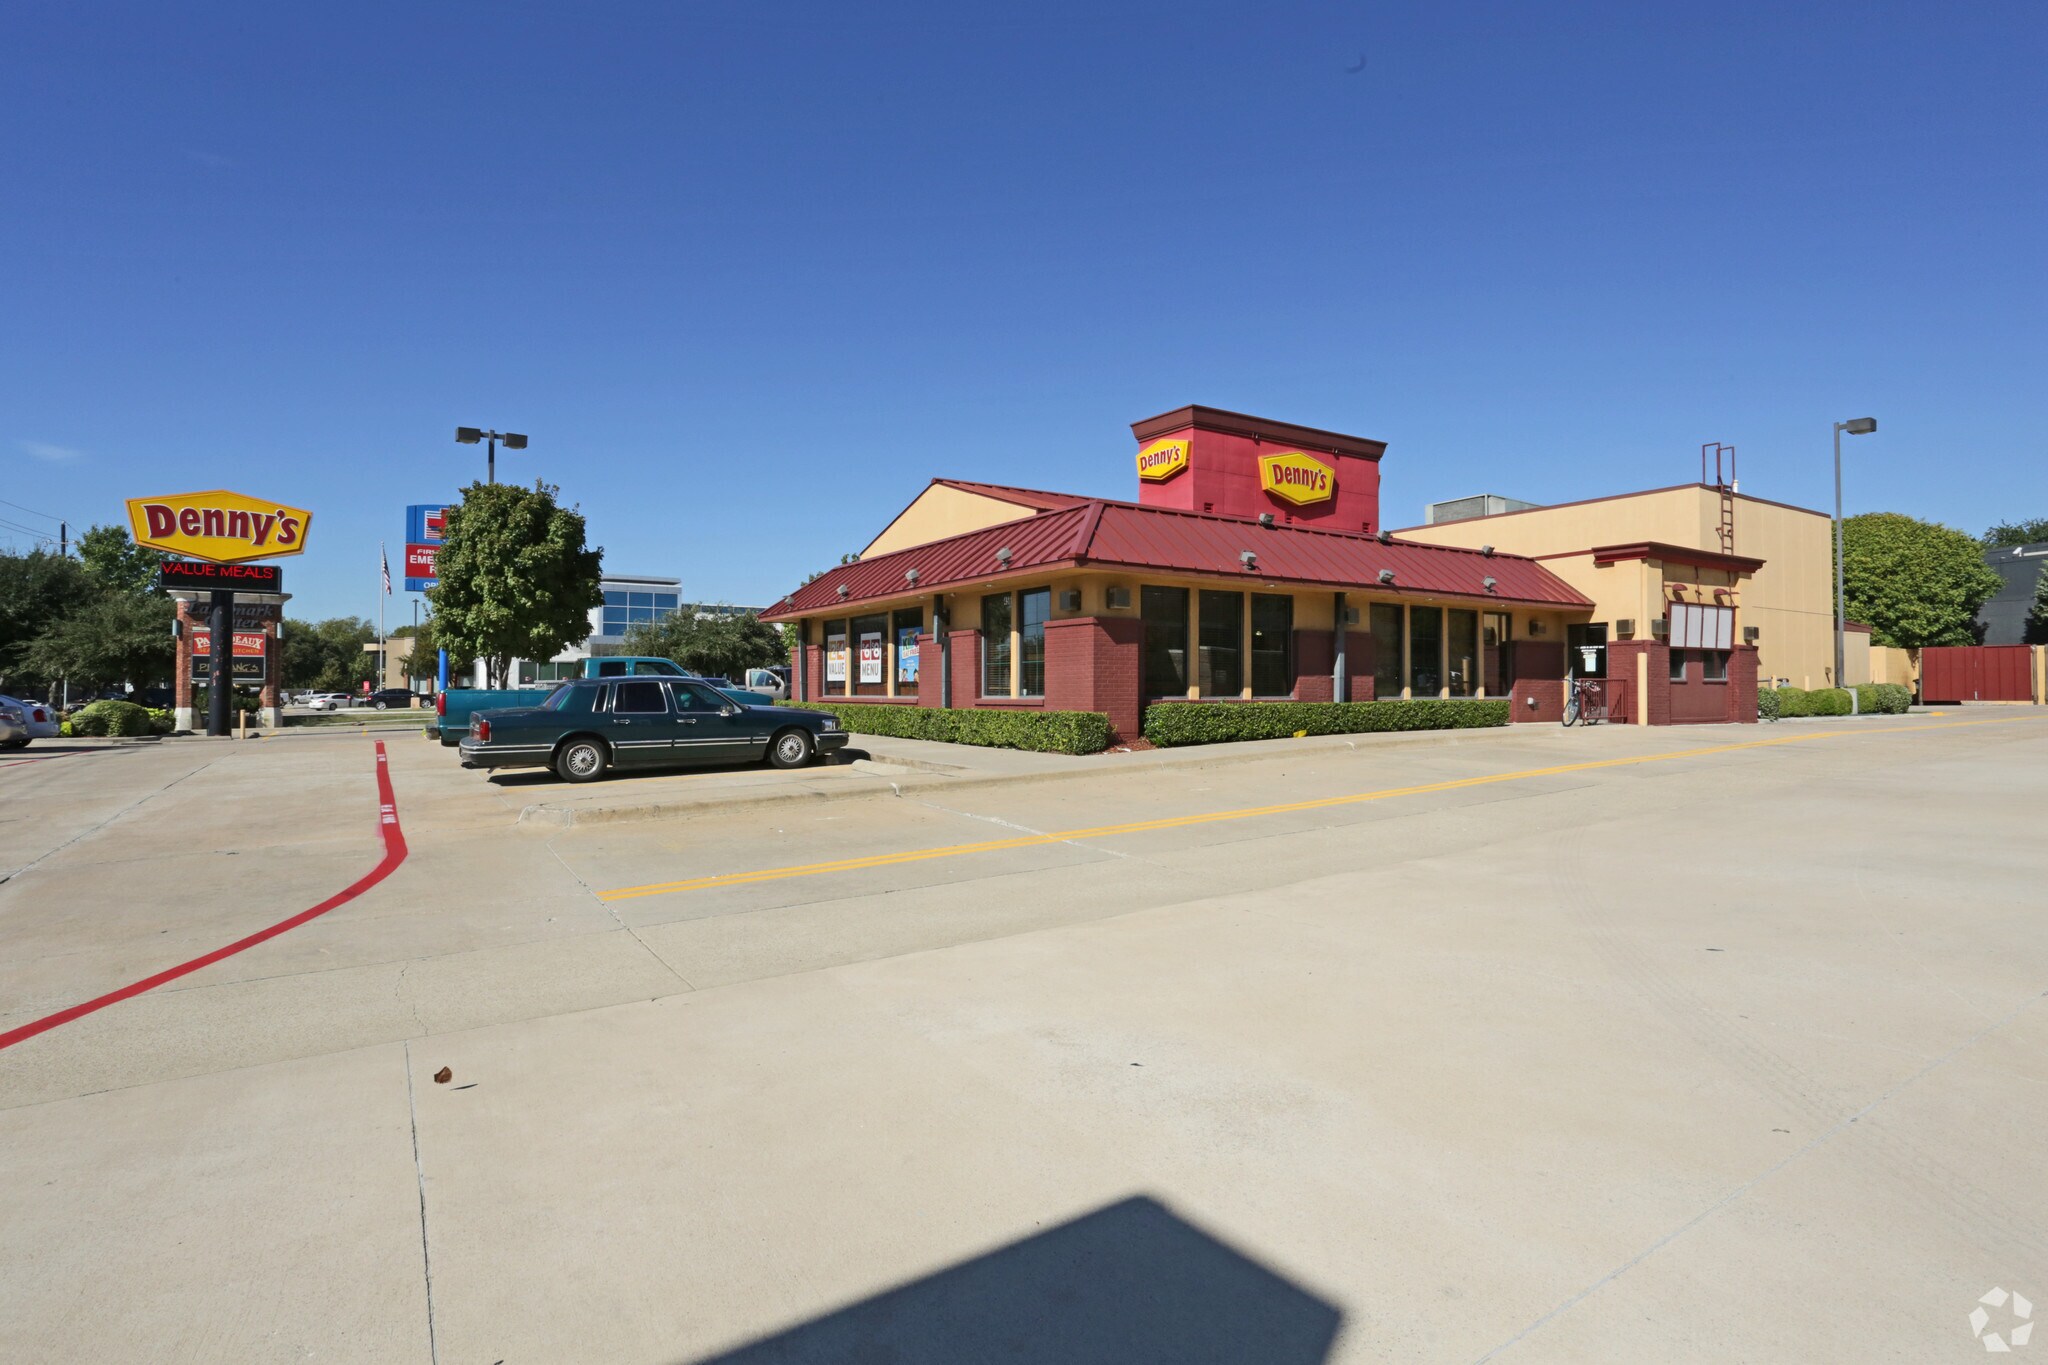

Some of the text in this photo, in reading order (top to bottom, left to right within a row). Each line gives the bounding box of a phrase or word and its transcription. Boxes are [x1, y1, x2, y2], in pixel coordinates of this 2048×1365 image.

[1140, 446, 1181, 471] Denny's
[1272, 464, 1326, 491] Denny's
[142, 503, 299, 547] Denny's
[161, 562, 273, 579] VALUE MEALS
[828, 662, 845, 675] VALUE
[862, 662, 879, 676] MENU
